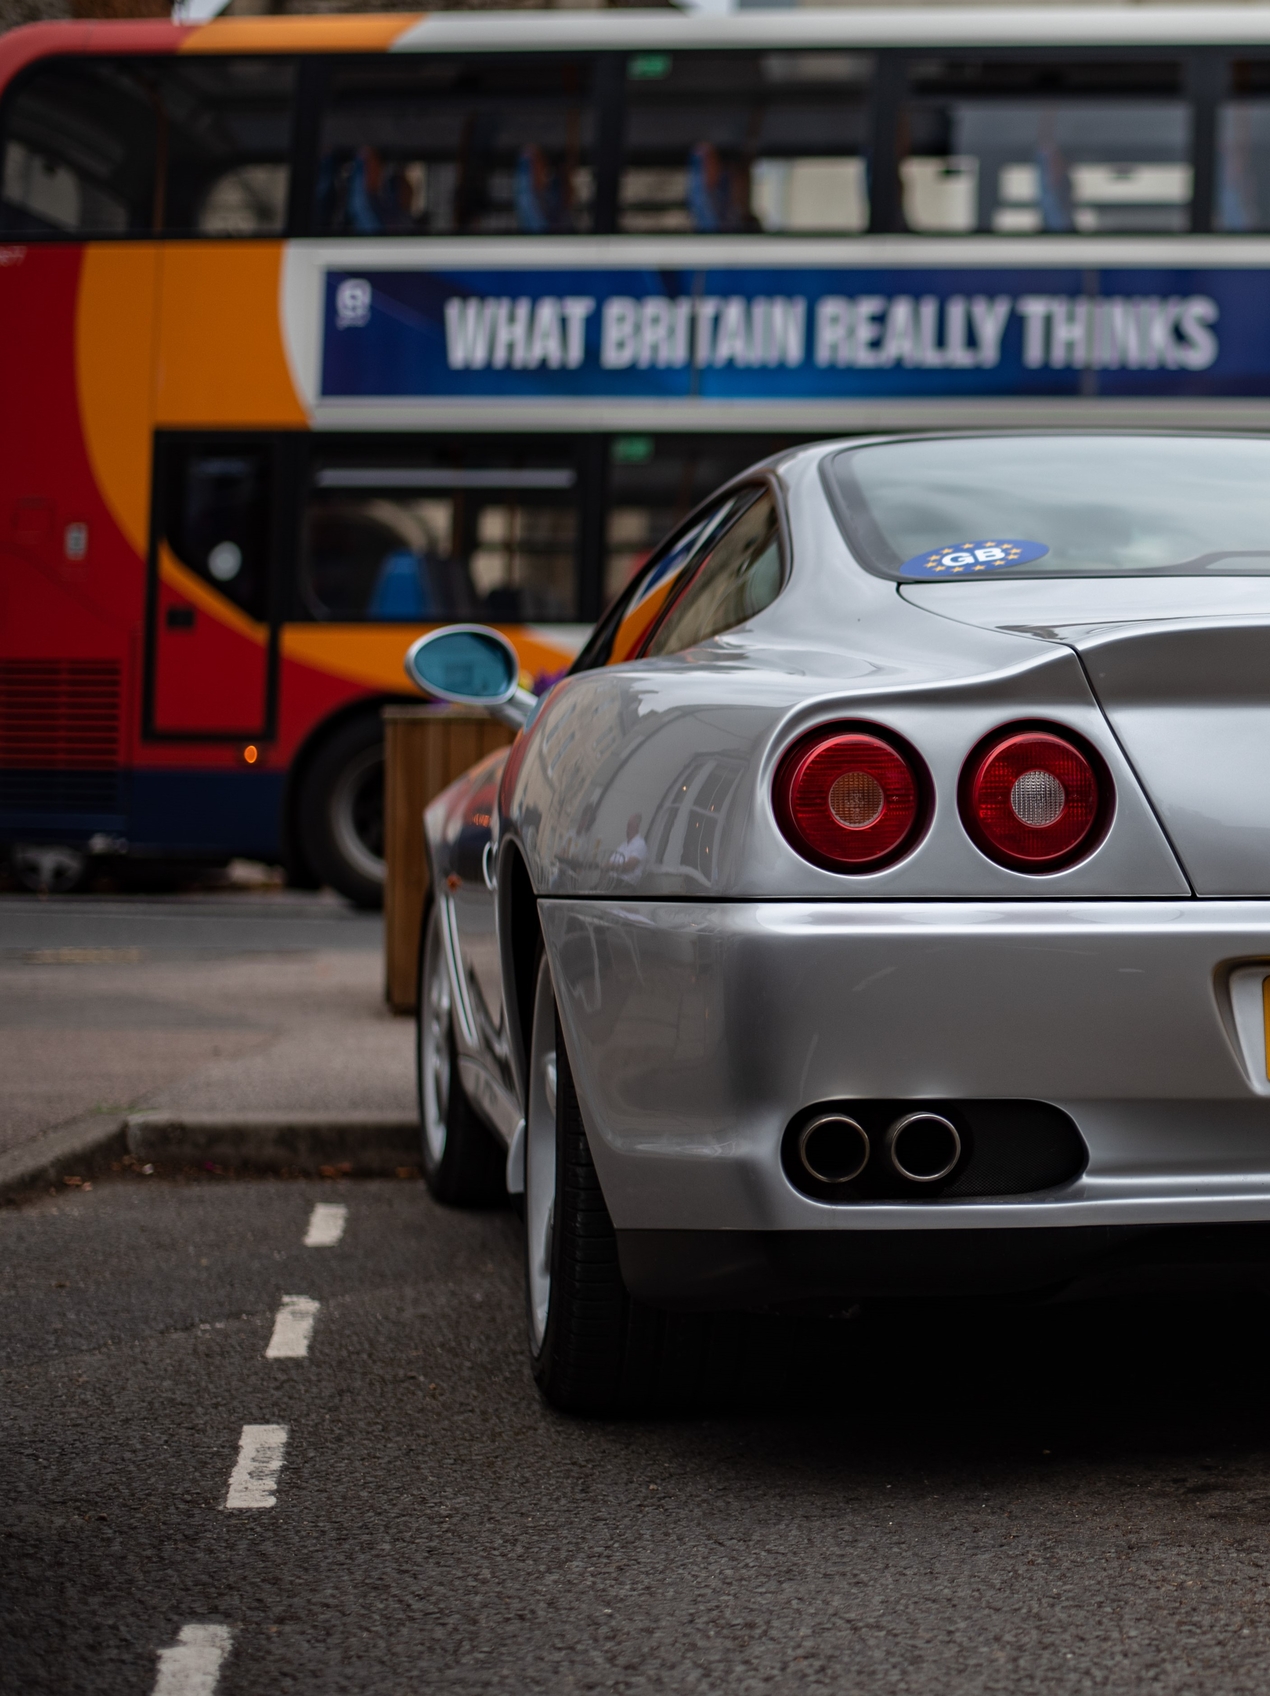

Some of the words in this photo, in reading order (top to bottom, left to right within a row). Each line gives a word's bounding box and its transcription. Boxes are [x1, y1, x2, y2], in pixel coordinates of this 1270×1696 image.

[444, 295, 596, 370] WHAT
[601, 295, 807, 370] BRITAIN
[814, 294, 1012, 369] REALLY
[1015, 294, 1219, 371] THINKS
[941, 547, 1006, 567] GB
